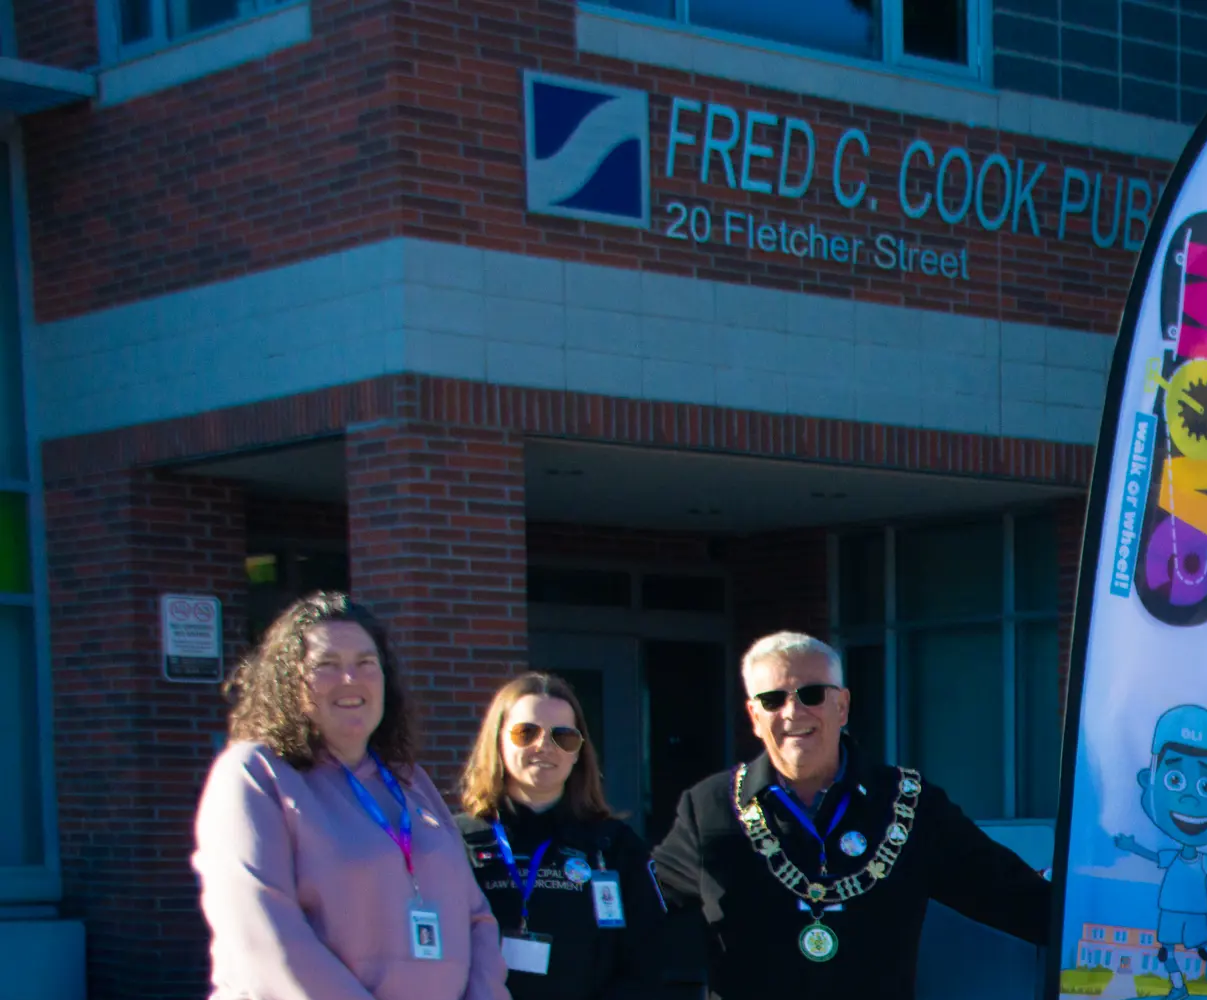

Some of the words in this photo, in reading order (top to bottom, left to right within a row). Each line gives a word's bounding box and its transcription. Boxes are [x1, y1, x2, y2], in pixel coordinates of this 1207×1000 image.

[665, 96, 816, 198] FRED
[833, 127, 877, 212] C.
[899, 139, 1048, 237] COOK
[1058, 166, 1164, 251] PUB
[665, 202, 712, 243] 20
[723, 209, 865, 265] Fletcher
[873, 234, 971, 280] Street
[1130, 420, 1149, 477] walk
[1125, 480, 1140, 509] or
[1113, 511, 1136, 590] wheel!
